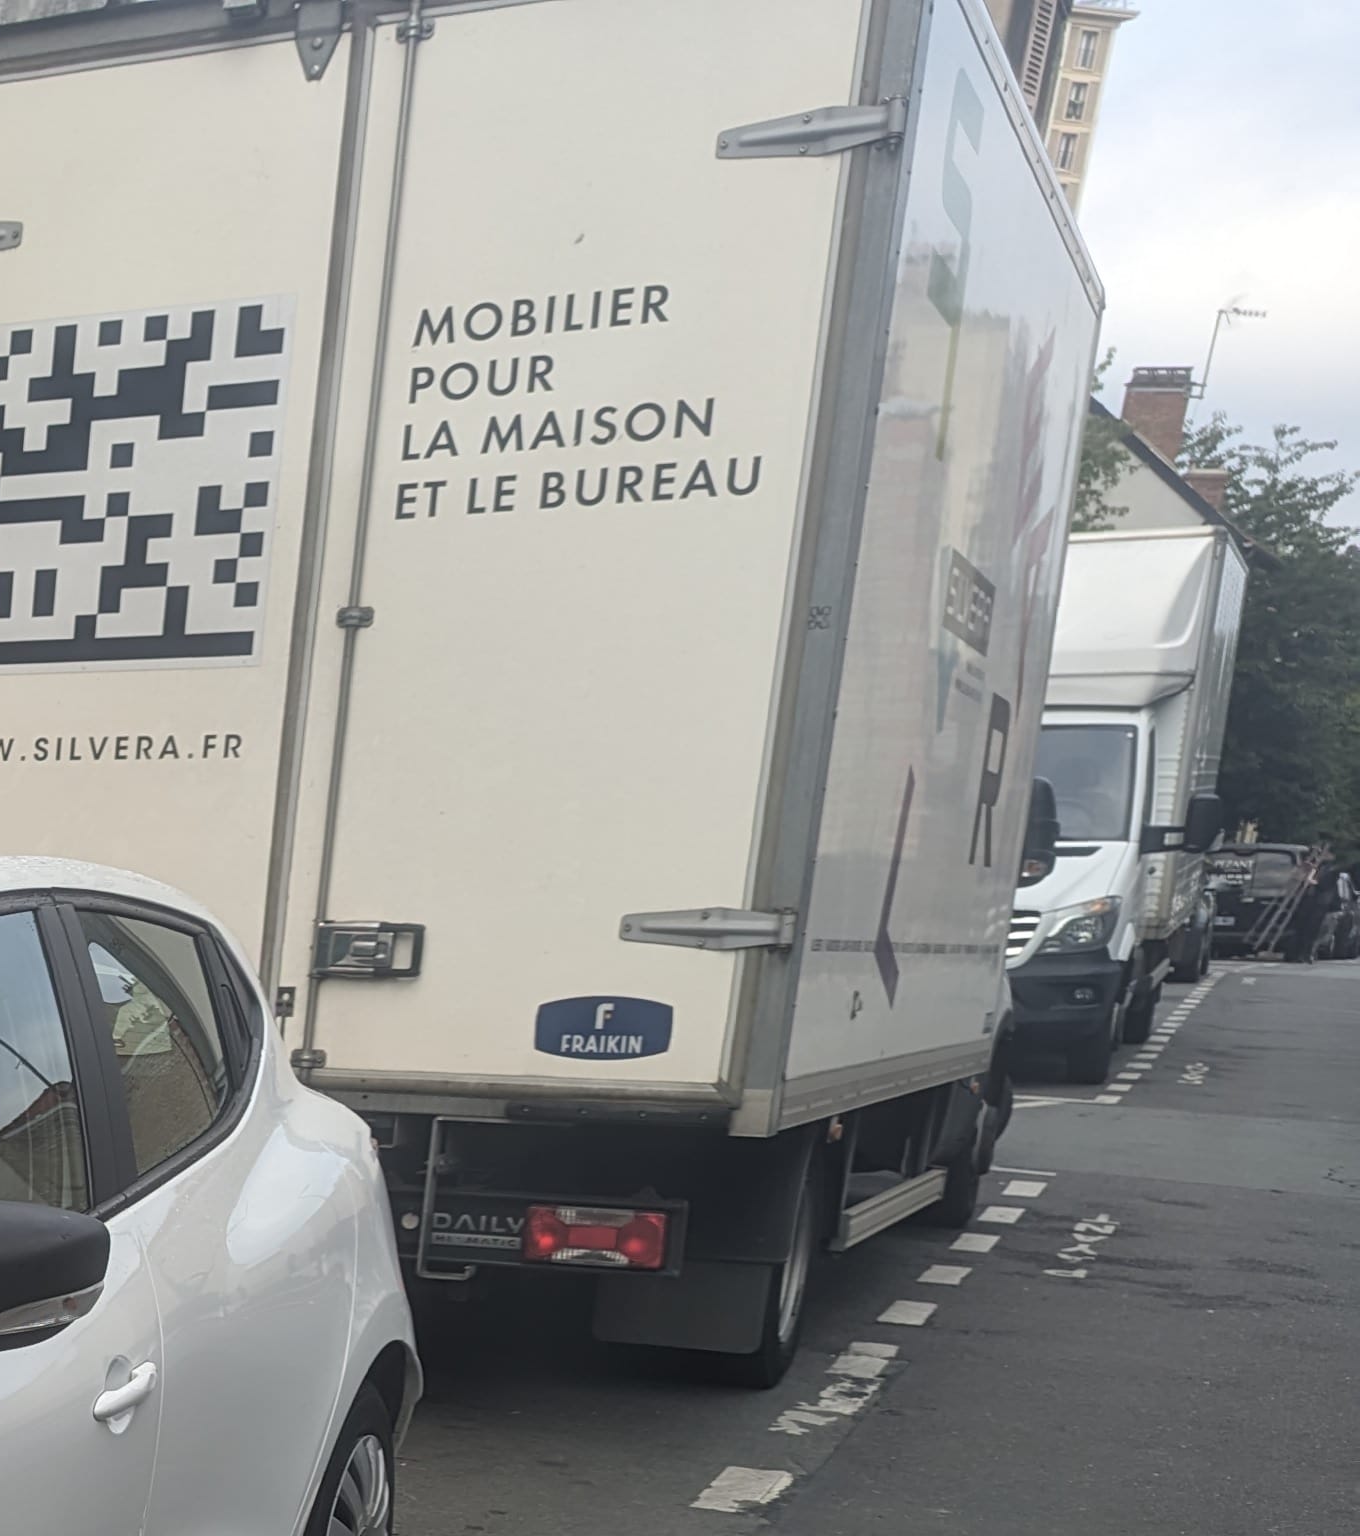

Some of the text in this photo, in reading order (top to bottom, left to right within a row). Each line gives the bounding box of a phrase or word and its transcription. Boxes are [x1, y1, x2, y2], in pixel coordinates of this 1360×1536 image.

[412, 284, 670, 348] MOBILIER
[408, 354, 555, 404] POUR
[401, 397, 716, 461] LA MAISON
[394, 455, 763, 521] ET LE BUREAU
[560, 1034, 644, 1054] FRAIKIN
[432, 1212, 525, 1234] DAILY
